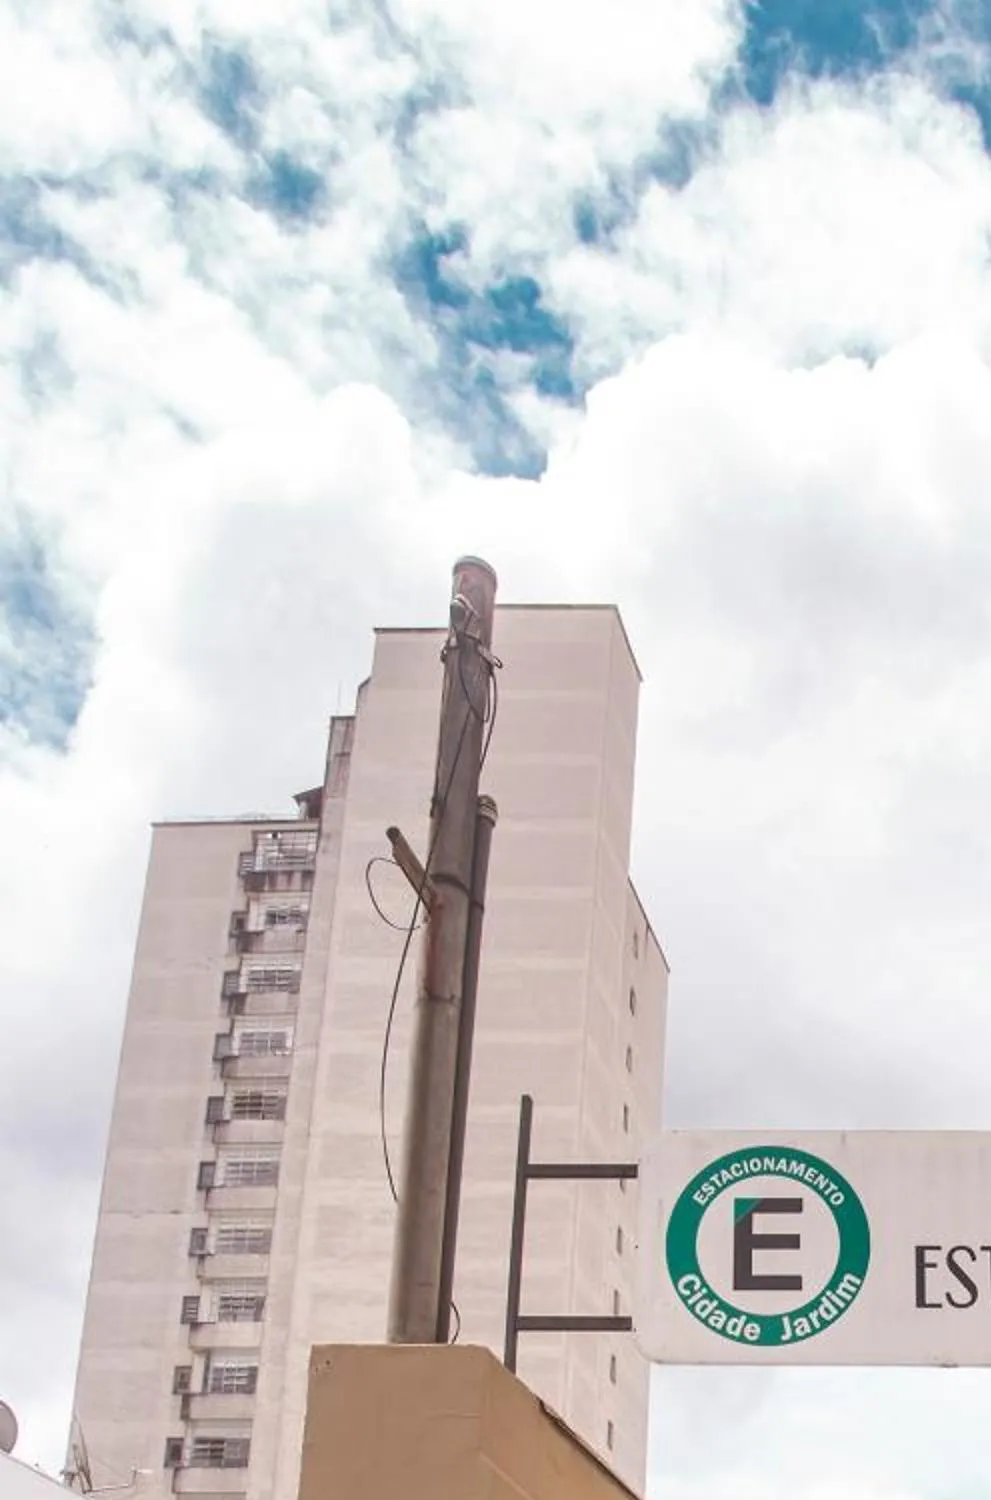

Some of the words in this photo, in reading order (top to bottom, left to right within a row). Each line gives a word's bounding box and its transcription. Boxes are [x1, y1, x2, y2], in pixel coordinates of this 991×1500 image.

[692, 1157, 846, 1207] ESTACIONAMENTO
[733, 1197, 803, 1290] E
[678, 1274, 761, 1341] Cidade
[780, 1274, 862, 1341] Jardim
